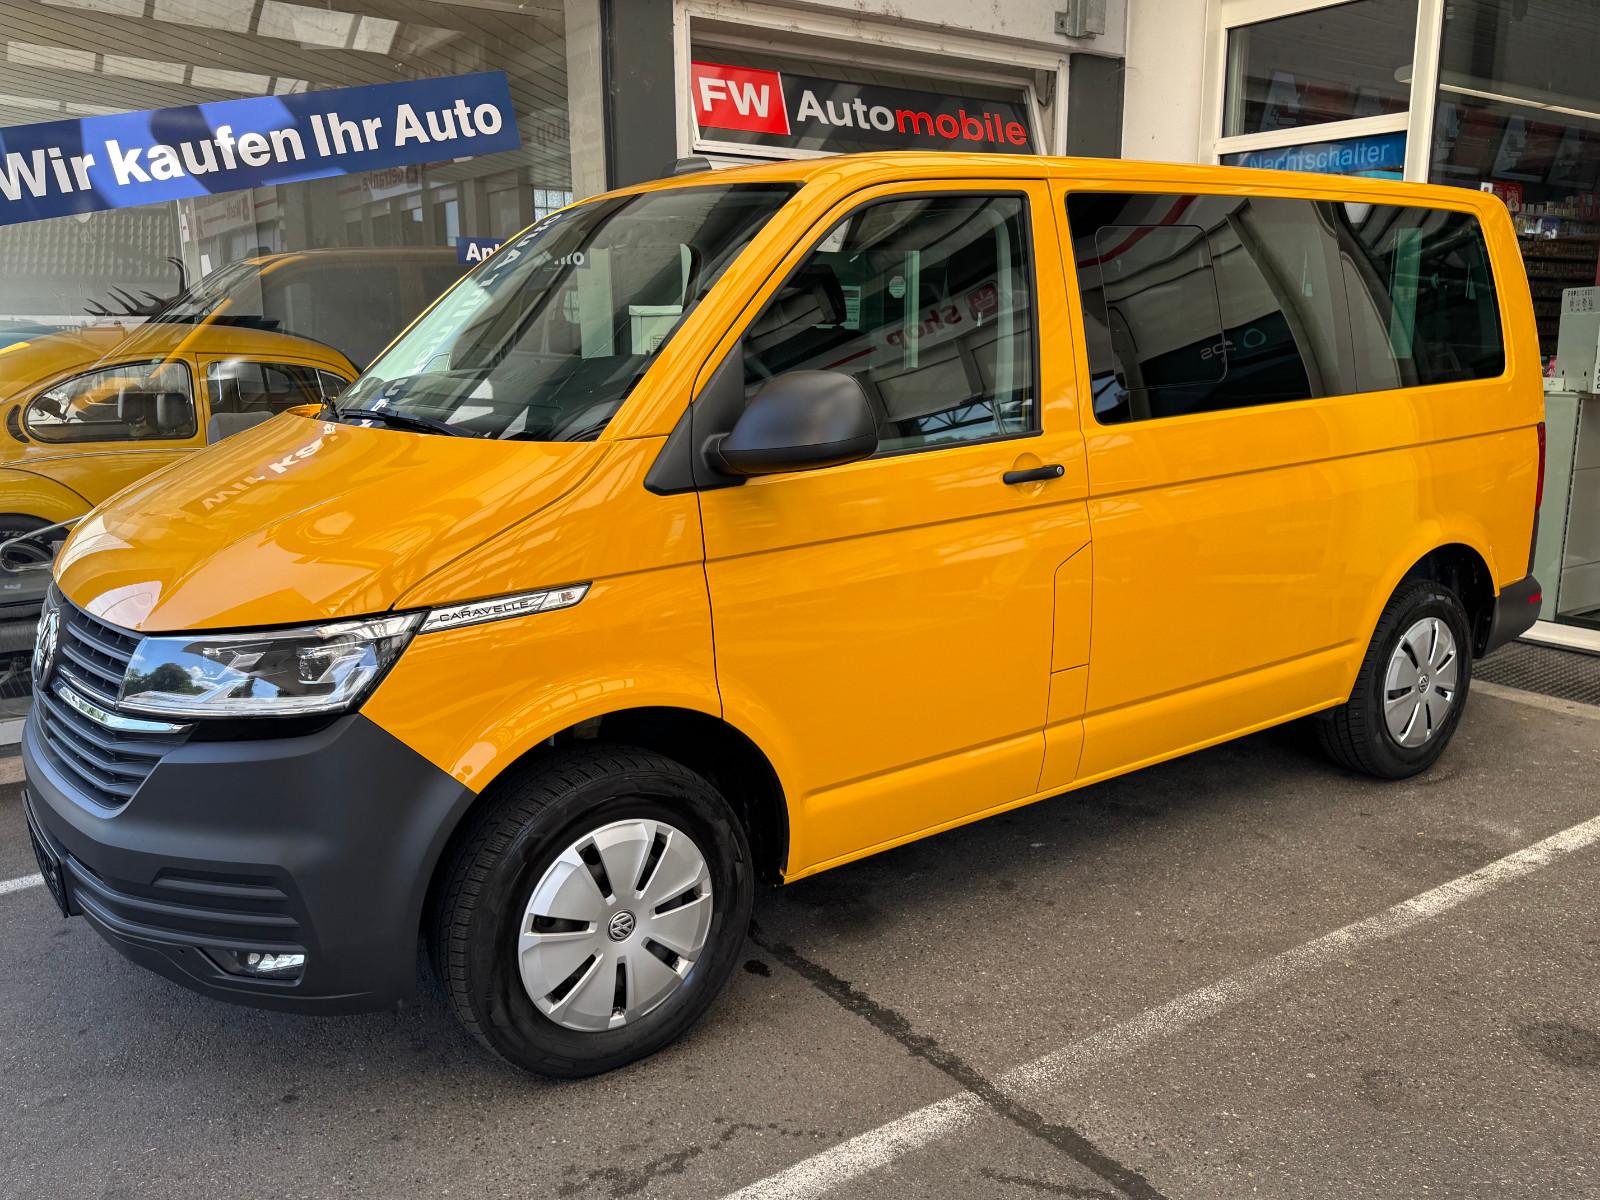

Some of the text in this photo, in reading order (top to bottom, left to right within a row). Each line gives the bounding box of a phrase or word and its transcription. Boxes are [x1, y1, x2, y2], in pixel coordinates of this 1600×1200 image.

[698, 76, 1027, 145] FW Automobile
[0, 147, 96, 201] Wir
[105, 125, 306, 186] kaufen
[310, 112, 383, 157] Ihr
[395, 99, 503, 147] Auto
[1250, 144, 1390, 171] Nachtschalter
[440, 601, 530, 622] CARAVELLE
